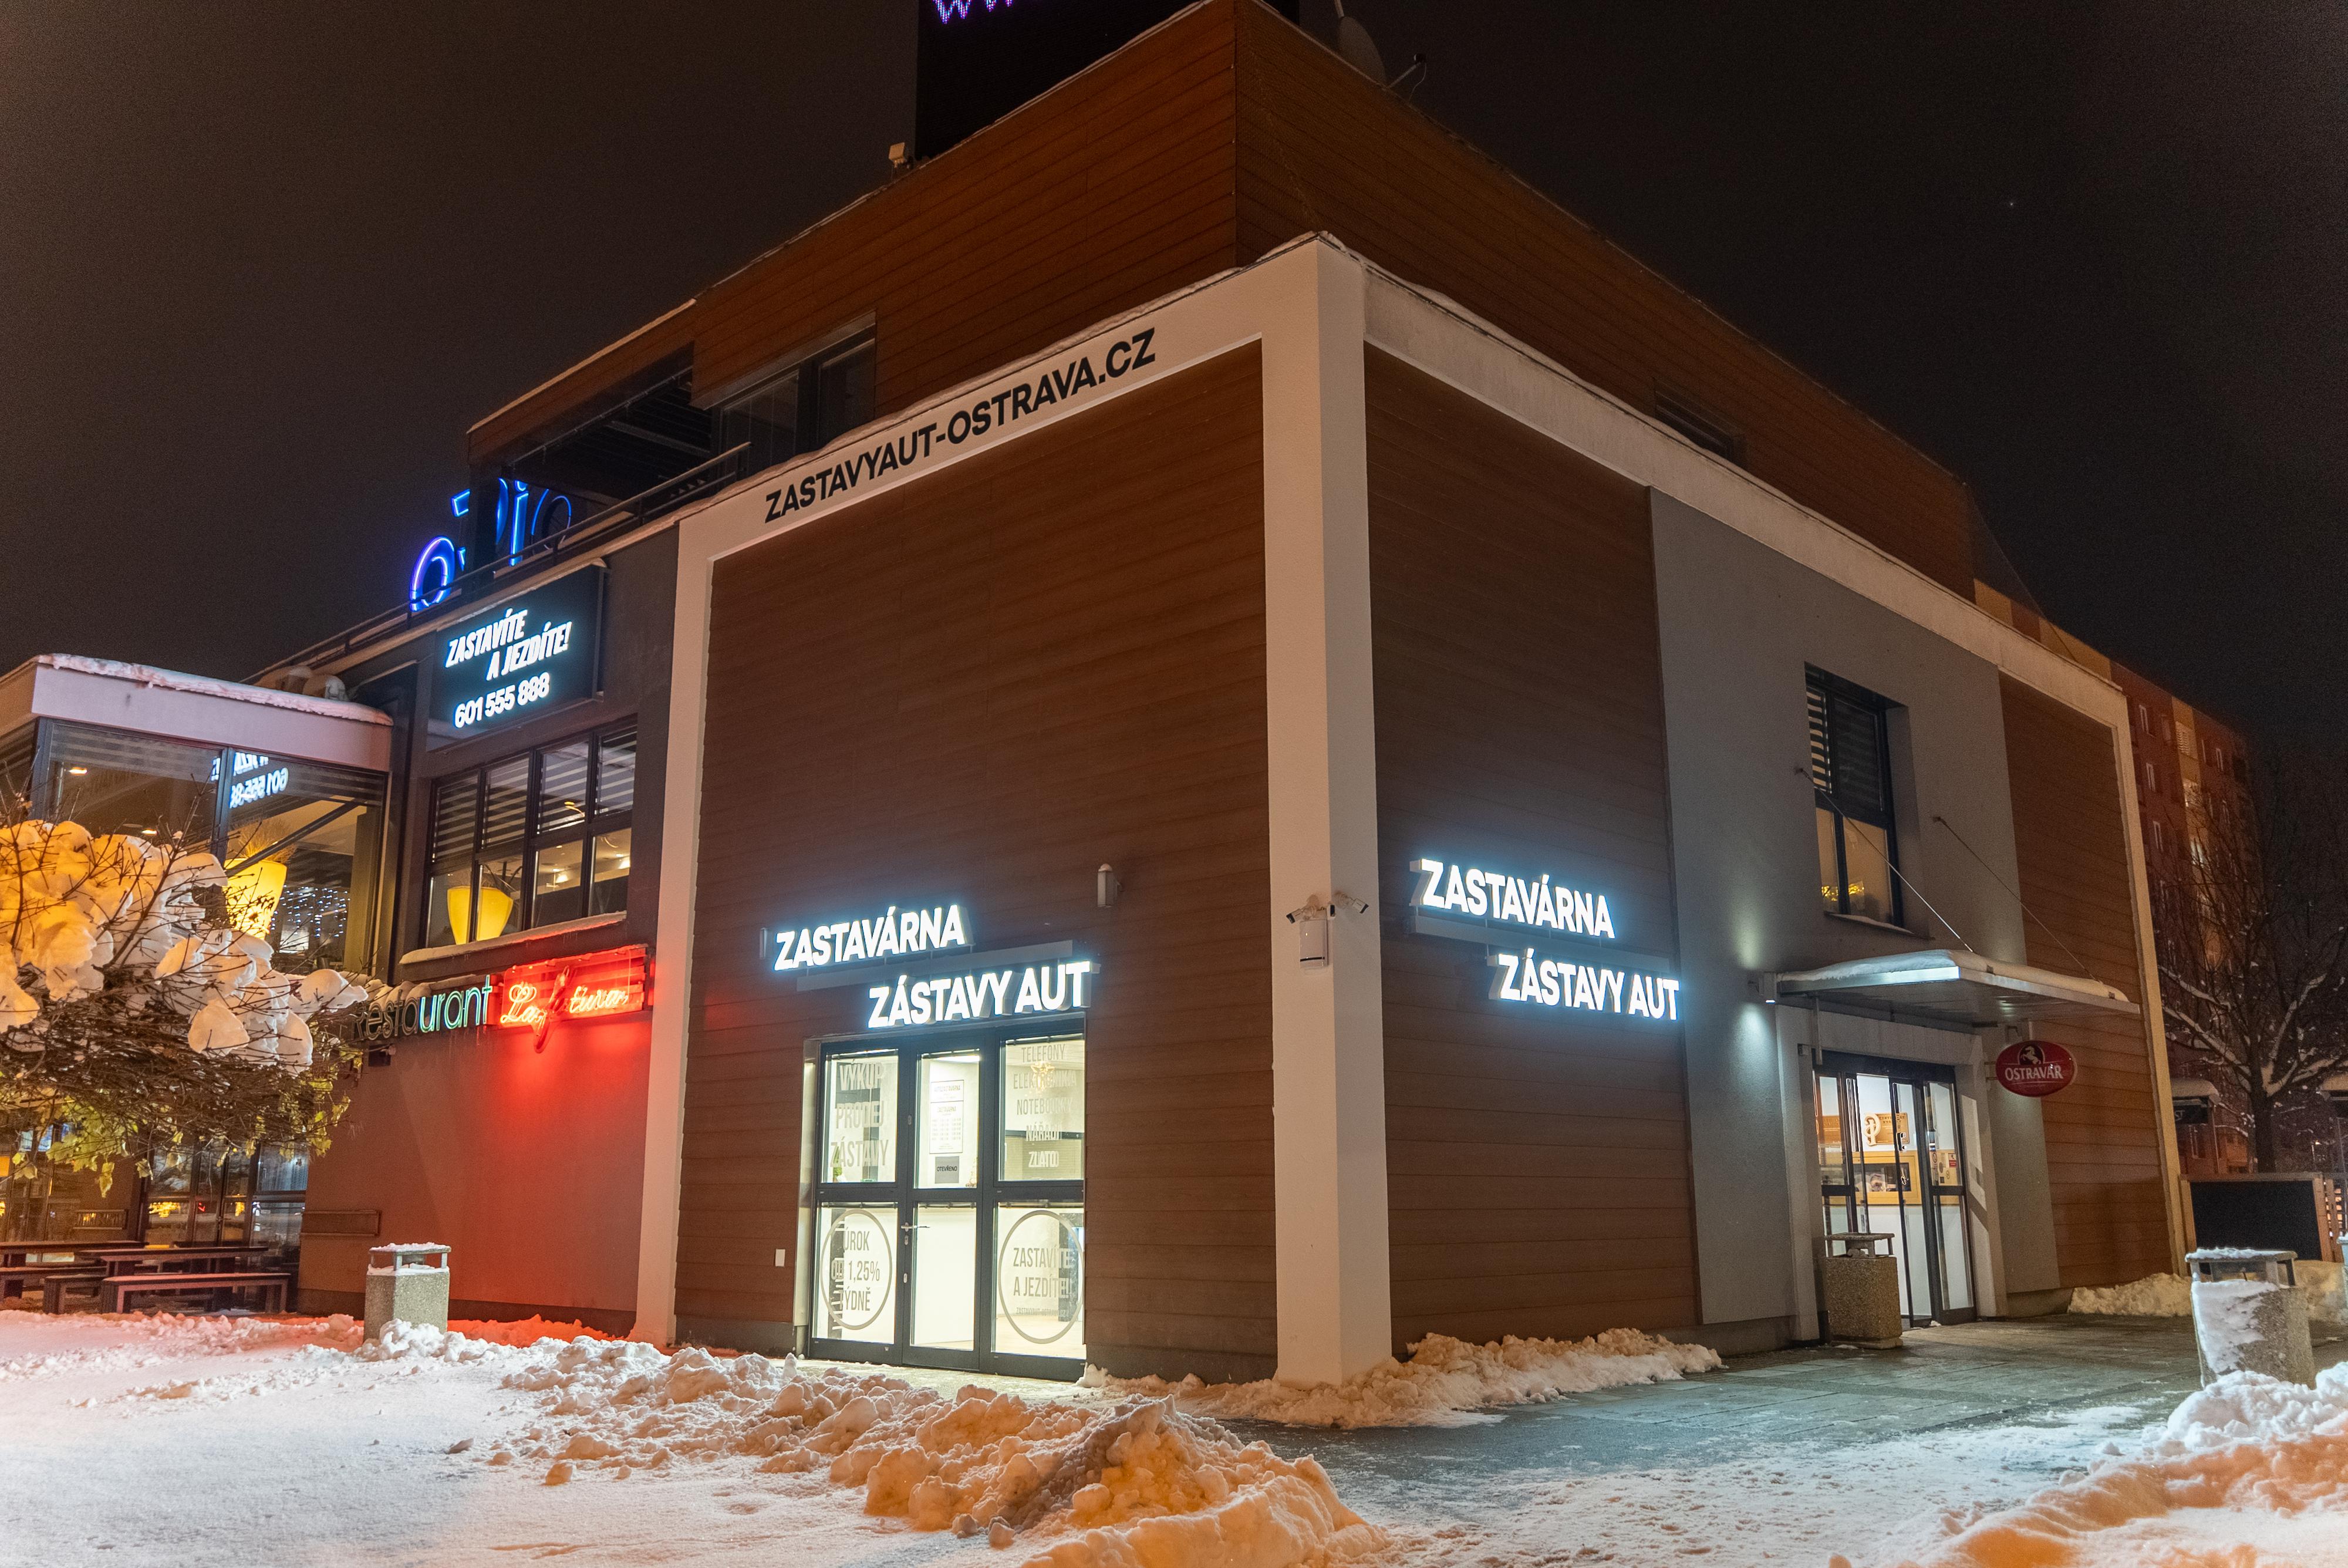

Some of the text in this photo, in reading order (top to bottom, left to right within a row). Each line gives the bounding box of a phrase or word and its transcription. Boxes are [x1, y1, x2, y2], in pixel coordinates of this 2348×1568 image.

[764, 327, 1155, 524] ZASTAVYAUT-OSTRAVA.CZ
[445, 608, 527, 667] ZASTAVÍTE
[486, 621, 572, 681] A JEZDÍTE!
[454, 672, 549, 728] 601 555 888
[1421, 858, 1616, 939] ZASTAVÁRNA
[774, 905, 966, 971] ZASTAVÁRNA
[868, 961, 1091, 1029] ZÁSTAVY AUT
[1498, 948, 1679, 1021] ZÁSTAVY AUT
[1021, 1044, 1065, 1063] TELEFONY
[839, 1059, 885, 1091] VÝKUP
[836, 1101, 884, 1129] PRODEJ
[830, 1136, 889, 1168] ZÁSTAVY
[1028, 1151, 1060, 1168] ZLATO
[843, 1227, 870, 1251] ÚROK
[848, 1260, 880, 1283] 1,25%
[1013, 1245, 1072, 1268] ZASTAVÍTE
[839, 1286, 871, 1311] TÝDNĚ
[1013, 1276, 1020, 1296] A
